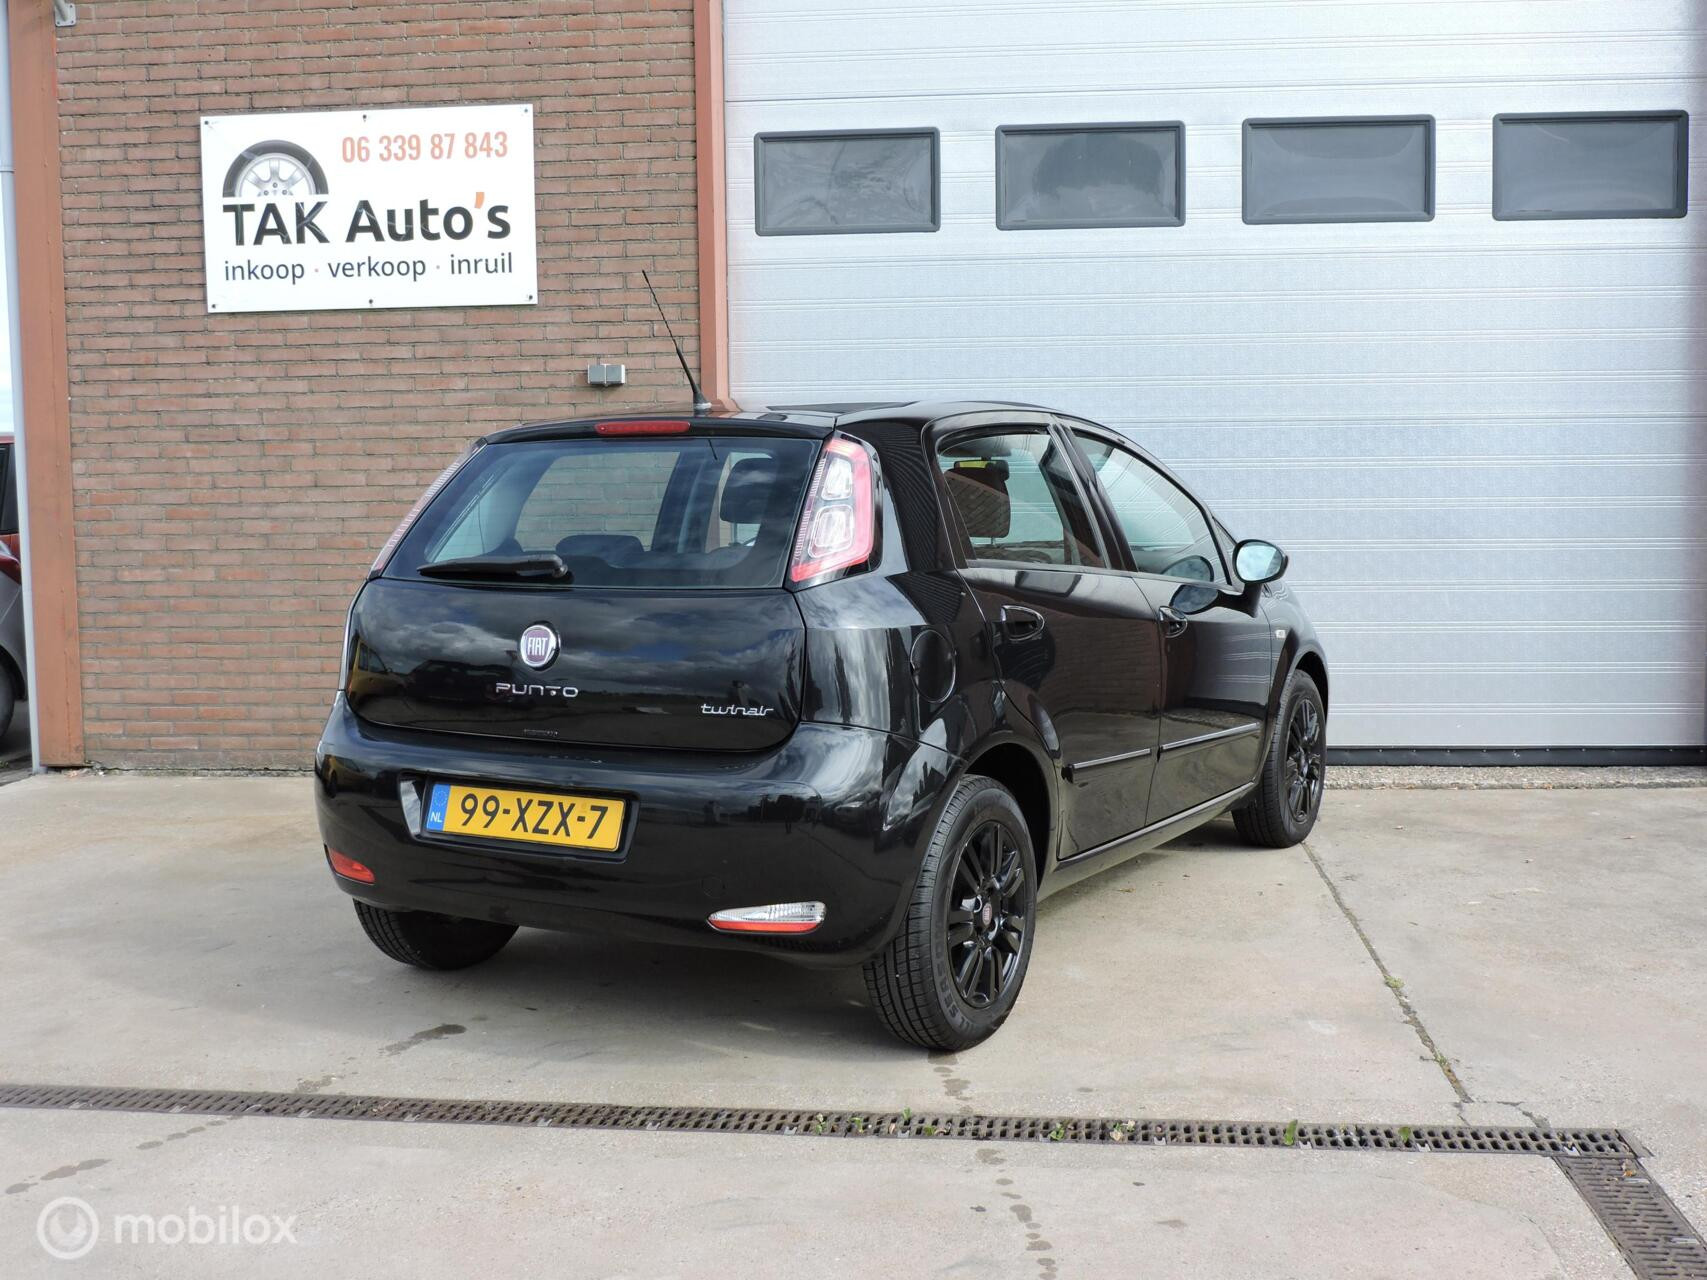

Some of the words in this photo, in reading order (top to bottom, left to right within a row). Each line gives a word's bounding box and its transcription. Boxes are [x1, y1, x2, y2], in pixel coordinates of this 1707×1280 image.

[342, 136, 370, 163] 06
[379, 134, 421, 161] 339
[430, 133, 456, 160] 87
[464, 131, 508, 158] 843
[222, 201, 330, 246] TAK
[345, 191, 511, 243] Auto's
[224, 260, 305, 285] inkoop
[328, 256, 426, 282] verkoop
[450, 252, 513, 275] inruil
[527, 637, 548, 656] FIAT
[495, 682, 579, 698] PUNTO
[700, 703, 774, 716] twinair
[430, 812, 443, 823] NL
[460, 793, 609, 840] 99-XZX-7
